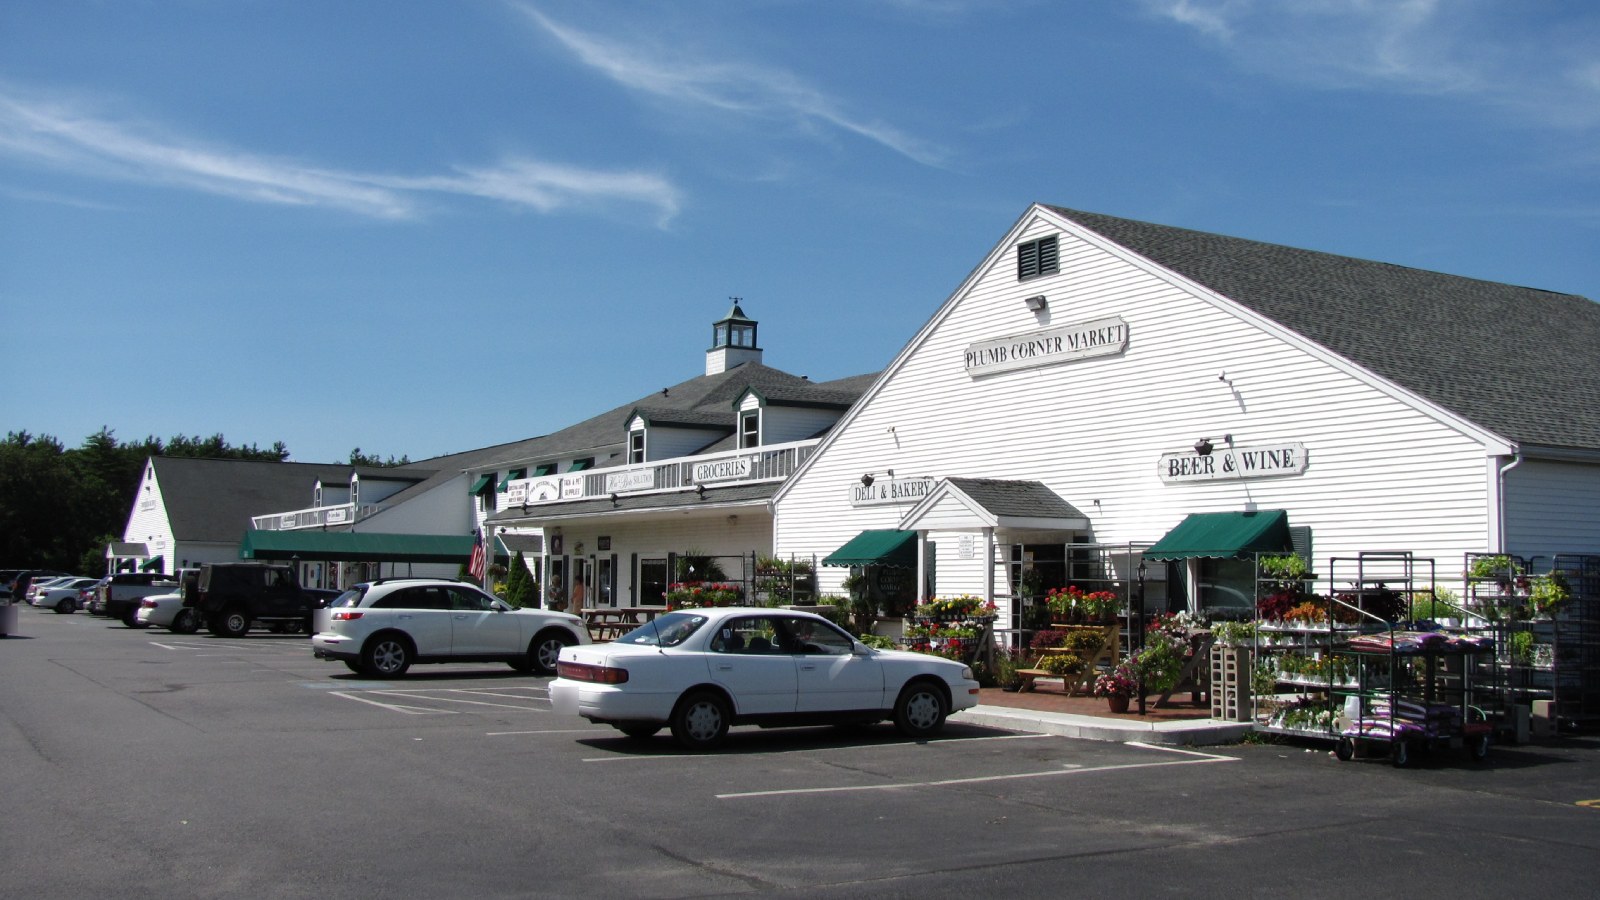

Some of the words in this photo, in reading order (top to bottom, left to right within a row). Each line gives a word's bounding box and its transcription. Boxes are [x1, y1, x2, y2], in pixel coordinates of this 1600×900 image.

[966, 346, 1007, 368] PLUMB
[1011, 336, 1062, 360] CORNER
[1067, 324, 1124, 350] MARKET
[697, 459, 746, 480] GROCERIES
[1168, 455, 1216, 477] BEER
[1222, 453, 1235, 473] &
[1242, 448, 1295, 471] WINE
[855, 485, 876, 501] DELI
[880, 484, 887, 499] &
[891, 481, 931, 499] BAKERY
